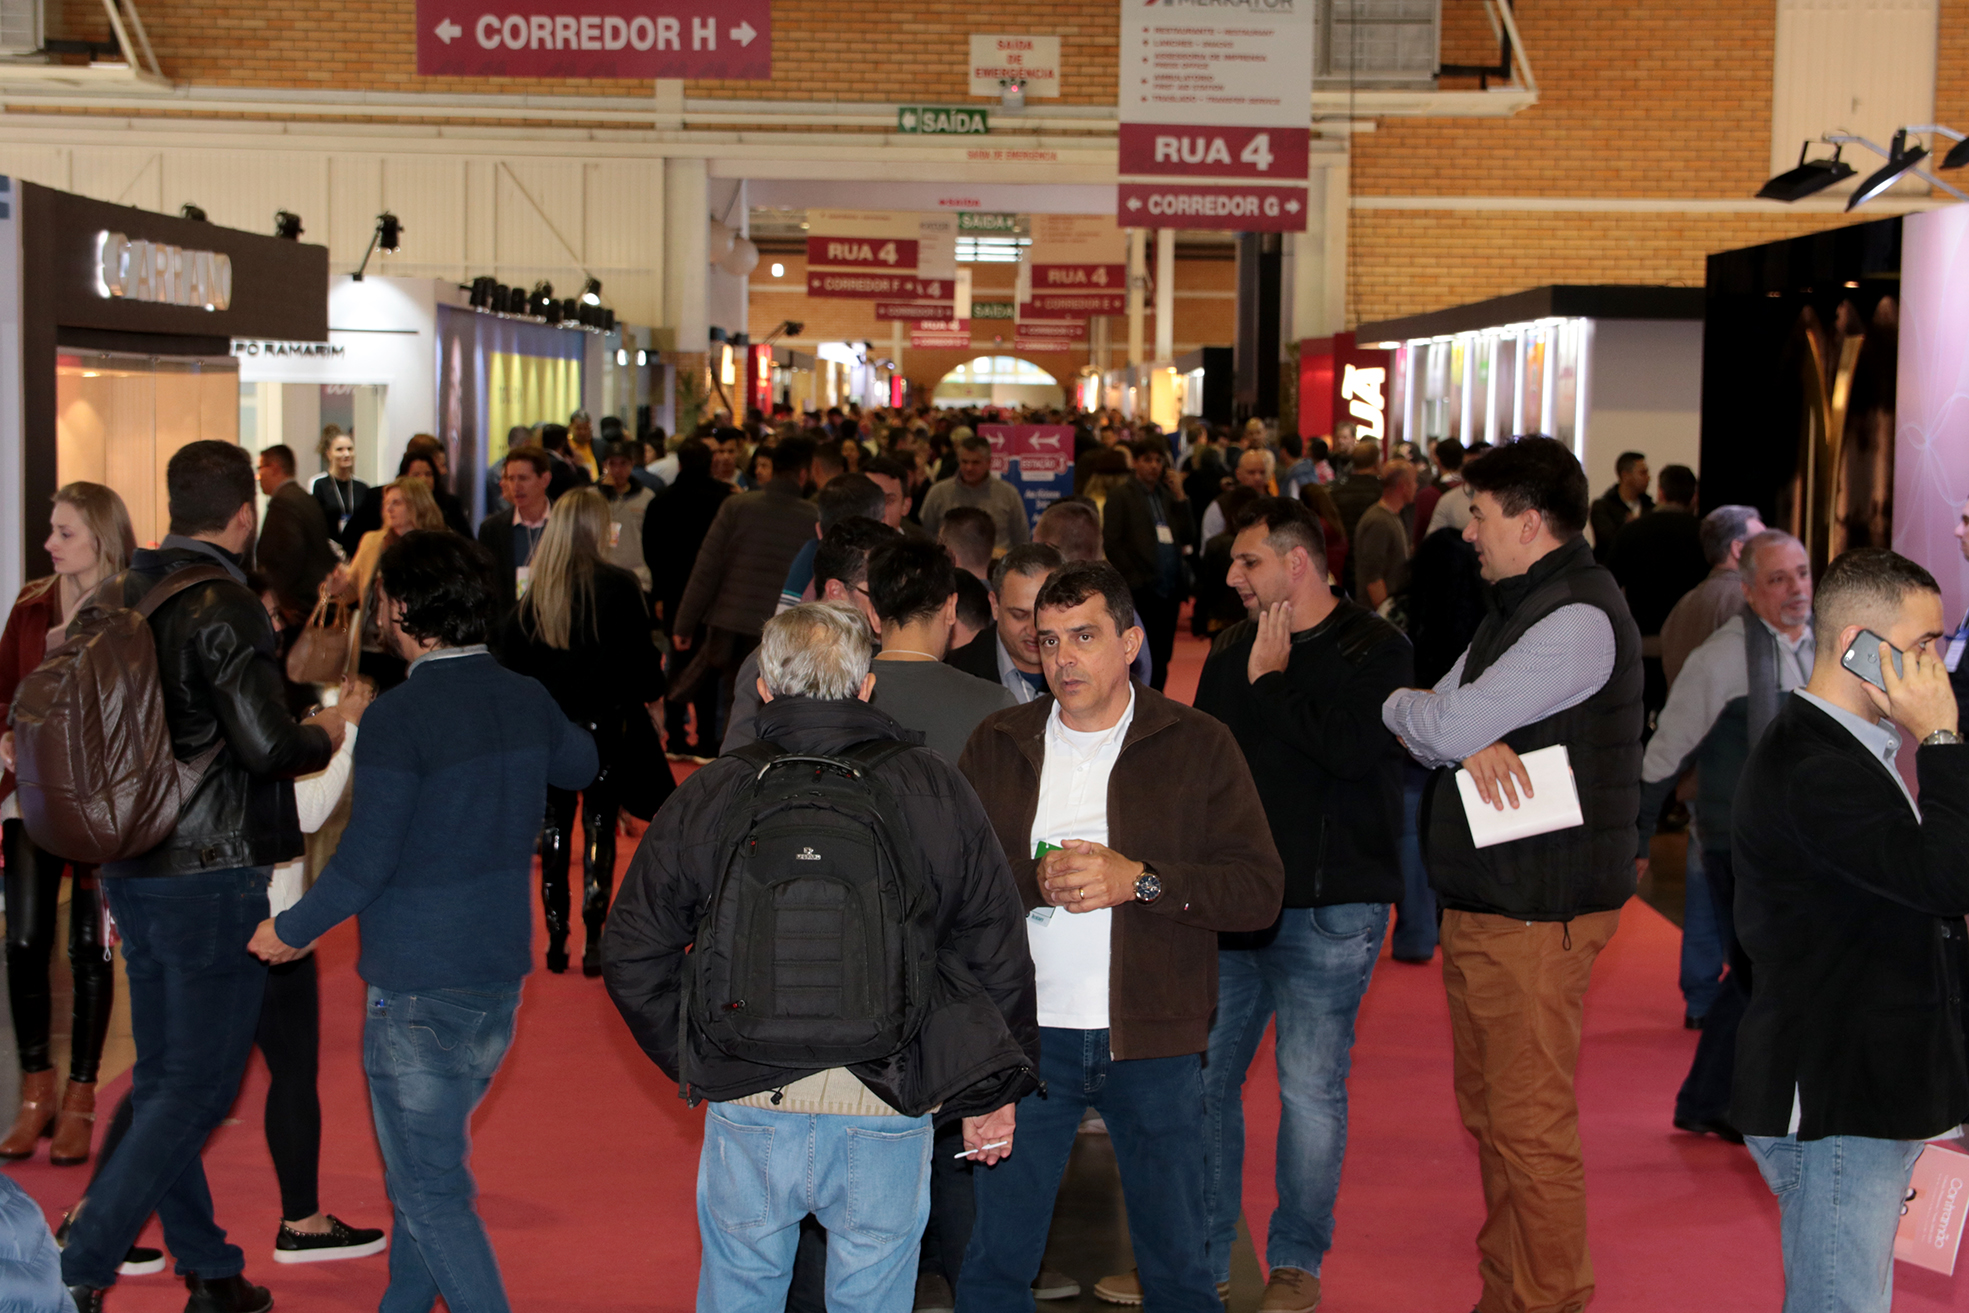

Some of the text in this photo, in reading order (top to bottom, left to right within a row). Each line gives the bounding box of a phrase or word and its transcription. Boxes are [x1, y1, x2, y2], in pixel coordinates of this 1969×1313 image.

[475, 14, 717, 51] CORREDOR H
[1006, 54, 1023, 65] DE
[922, 110, 986, 133] SAÍDA
[1154, 132, 1275, 171] RUA 4
[1147, 194, 1280, 217] CORREDOR G
[827, 242, 874, 261] RUA
[877, 241, 899, 265] 4
[823, 277, 890, 292] CORREDOR
[1047, 266, 1109, 287] RUA 4
[264, 343, 345, 359] RAMARIM
[1934, 1177, 1963, 1249] Contramão
